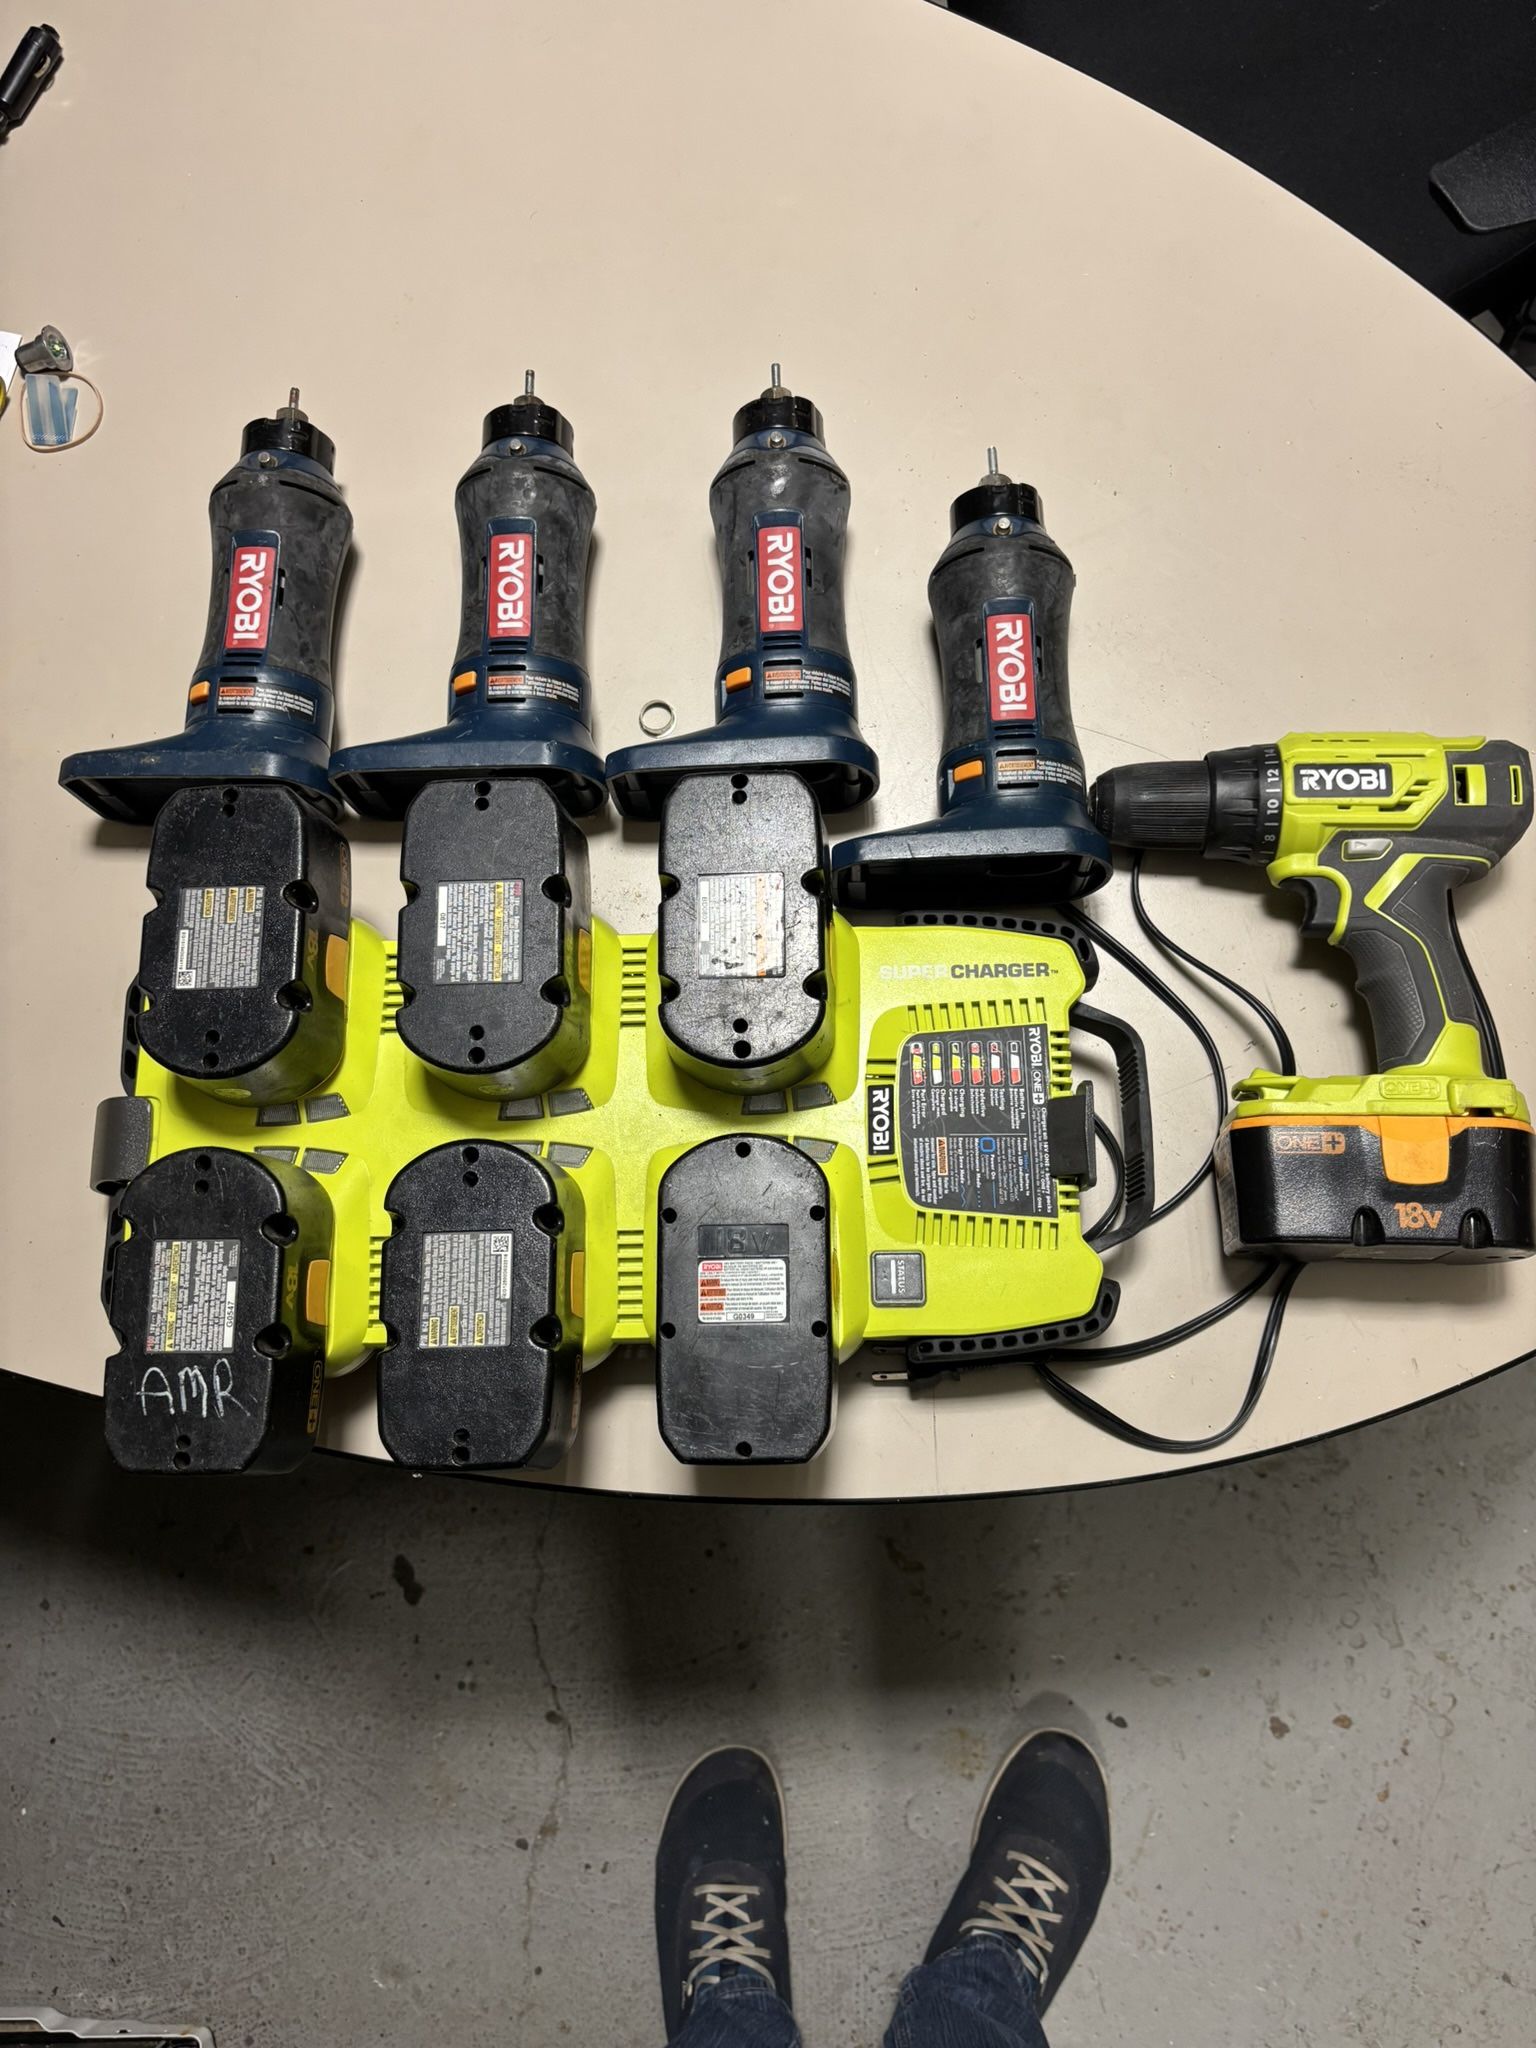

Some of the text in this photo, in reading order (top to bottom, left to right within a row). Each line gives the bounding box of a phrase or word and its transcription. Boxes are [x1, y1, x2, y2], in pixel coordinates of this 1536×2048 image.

[234, 552, 266, 639] RYOBI
[498, 540, 526, 626] RYOBI
[767, 533, 794, 622] RYOBI
[996, 620, 1027, 711] RYOBI
[1264, 748, 1277, 758] 14
[1267, 768, 1280, 783] 12
[1299, 768, 1387, 791] RYOBI
[1267, 799, 1280, 815] 10
[1264, 834, 1276, 842] 8
[1028, 1026, 1042, 1067] RYOBI
[873, 1088, 889, 1150] RYOBI
[897, 1260, 906, 1294] STATUS
[226, 1300, 234, 1328] G0547
[136, 1358, 251, 1419] AMR
